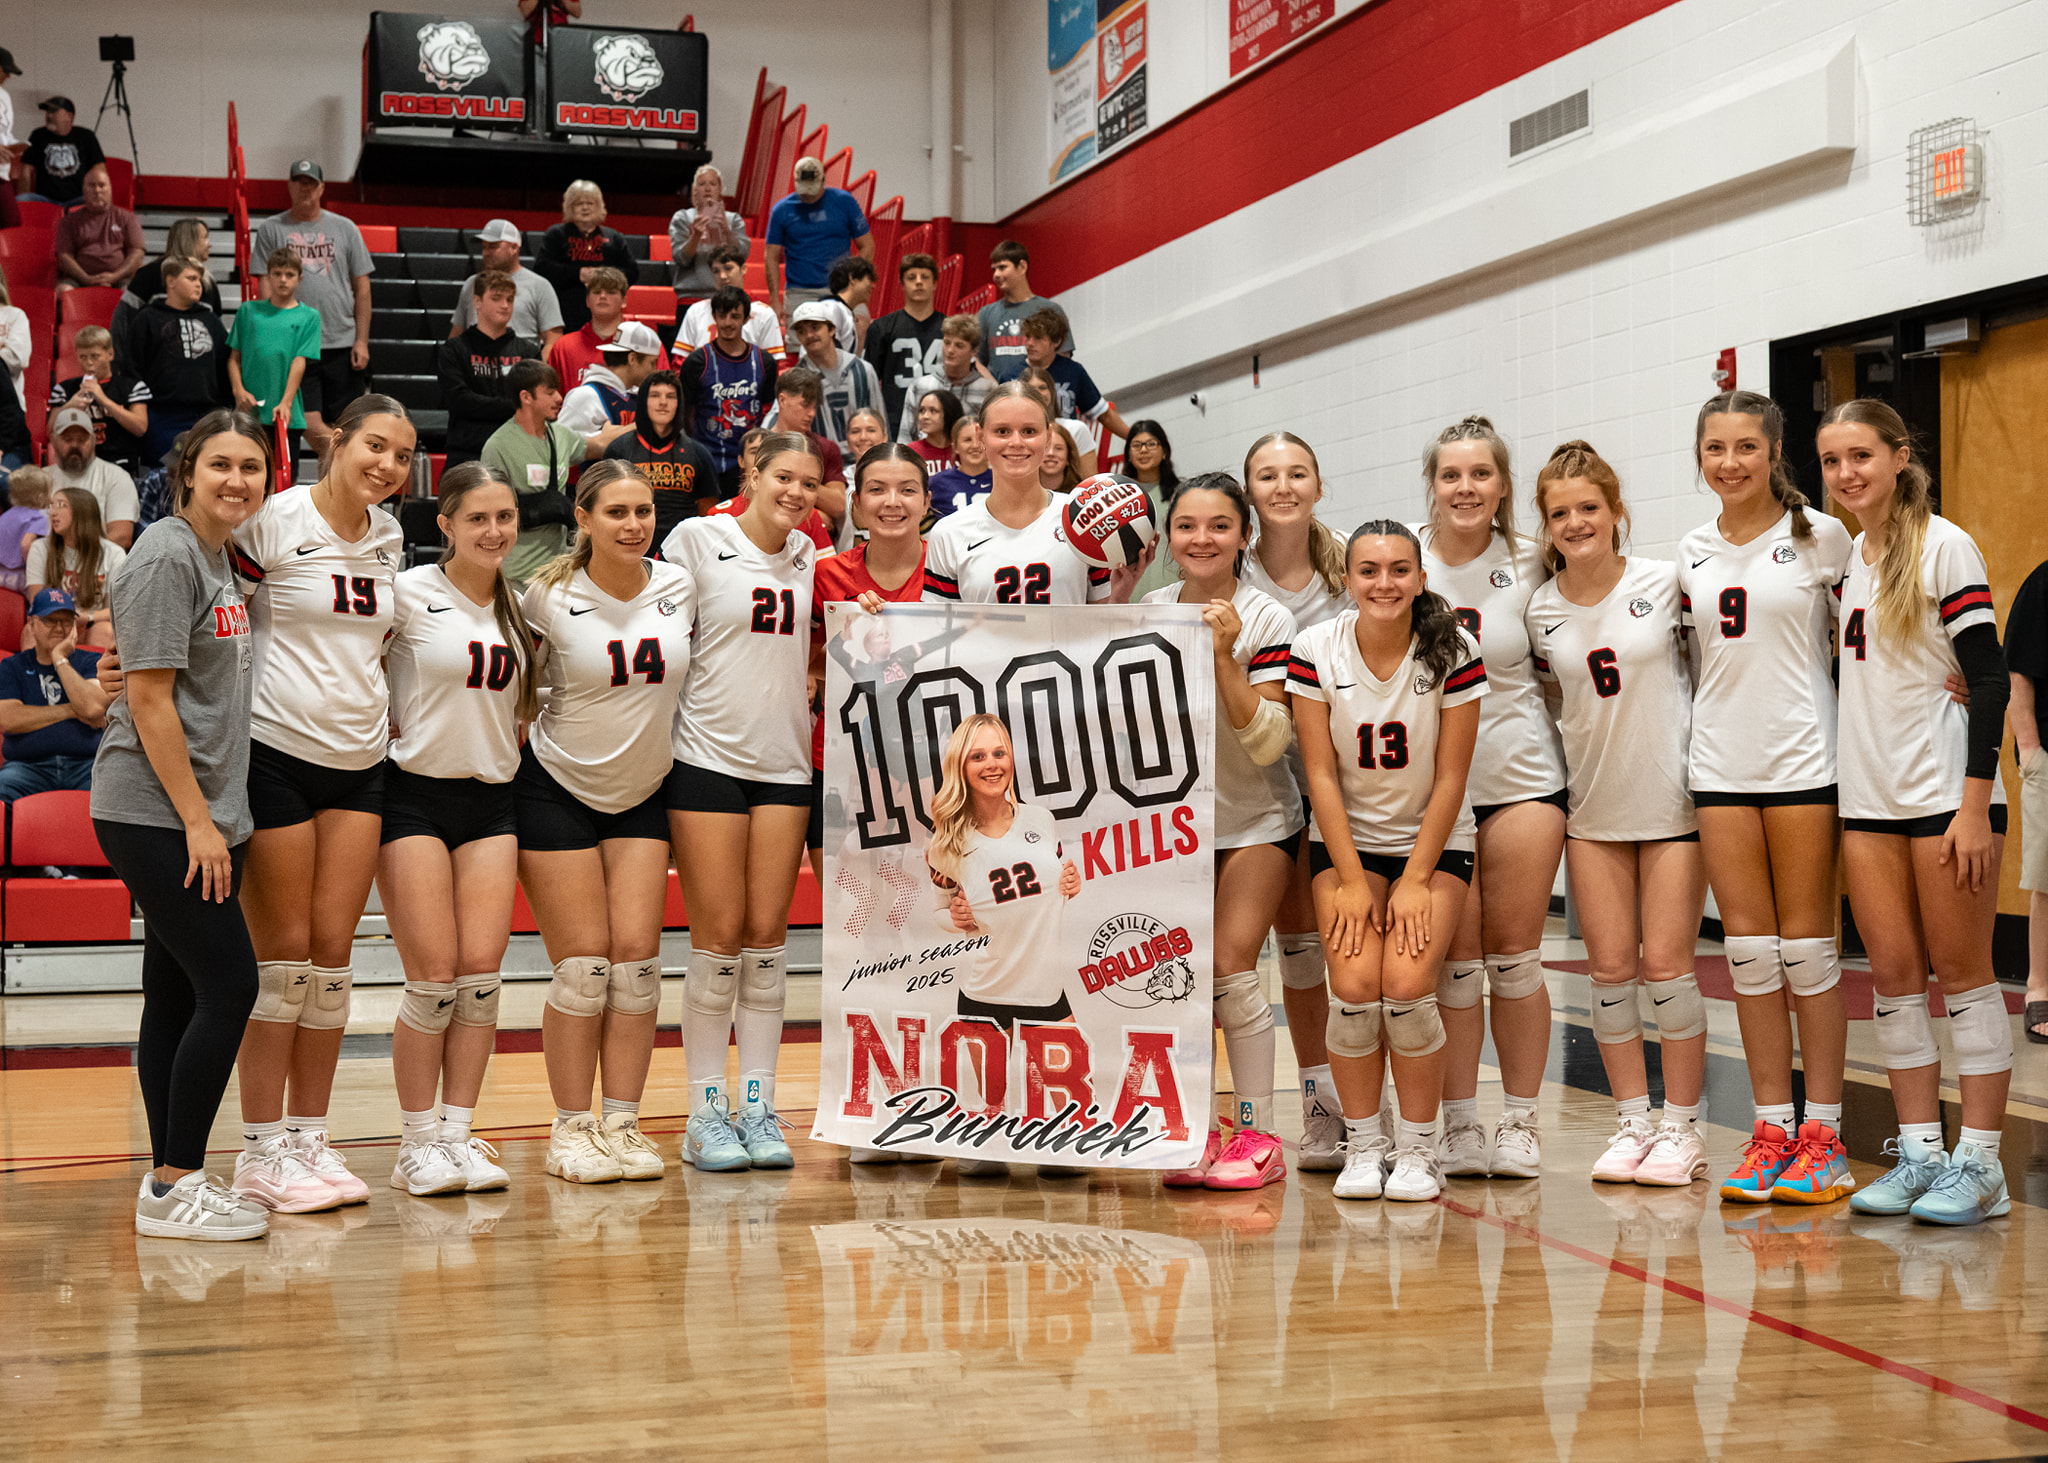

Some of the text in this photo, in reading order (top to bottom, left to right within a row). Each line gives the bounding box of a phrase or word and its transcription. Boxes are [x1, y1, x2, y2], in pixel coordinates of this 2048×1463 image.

[382, 93, 525, 120] ROSSVILLE
[558, 104, 697, 132] ROSSVILLE
[1934, 147, 1966, 197] EXIT
[1076, 479, 1117, 507] Nora
[1076, 483, 1137, 530] 1000 KILLS
[1090, 498, 1145, 541] RHS #22
[331, 574, 377, 616] 19
[994, 562, 1051, 604] 22
[751, 587, 795, 635] 21
[1719, 587, 1748, 639] 9
[1844, 608, 1867, 661] 4
[466, 640, 515, 691] 10
[608, 638, 666, 687] 14
[1586, 647, 1622, 698] 6
[840, 632, 1200, 850] 1000
[1356, 721, 1409, 770] 13
[1082, 805, 1199, 881] KILLS
[988, 861, 1042, 904] 22
[1078, 926, 1193, 995] DAWGS
[1090, 916, 1160, 959] ROSSVILLE
[842, 934, 992, 992] junior season
[906, 967, 956, 993] 2025
[843, 1010, 1191, 1143] NORA
